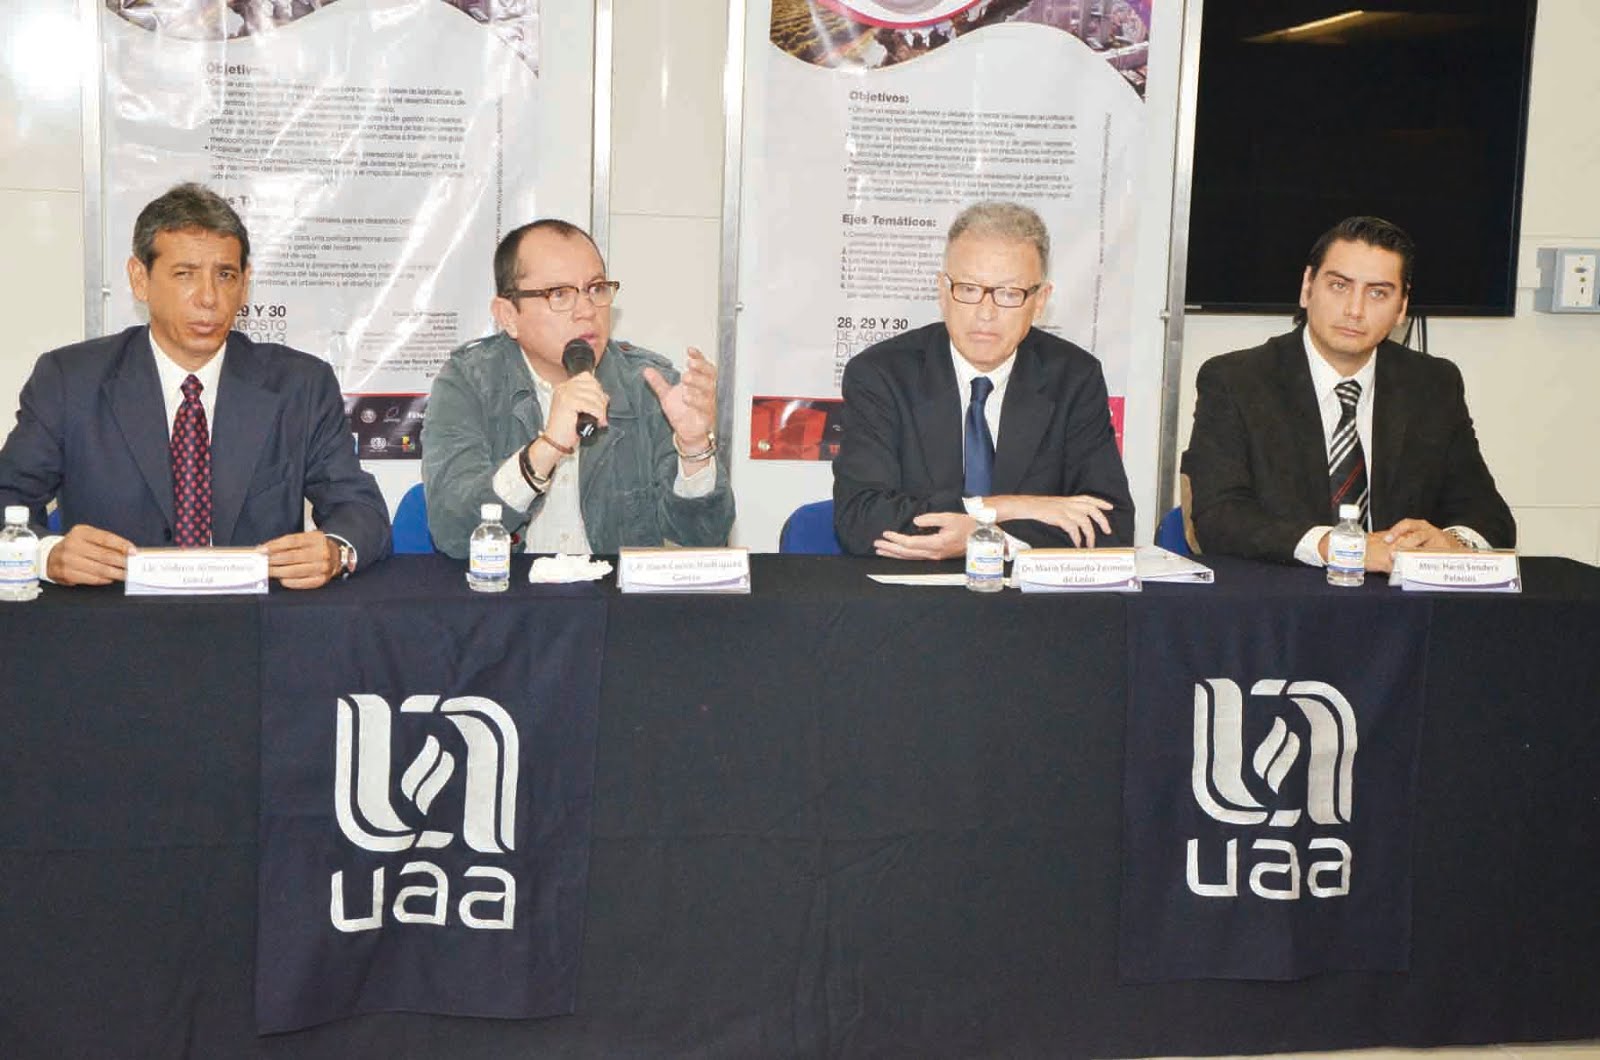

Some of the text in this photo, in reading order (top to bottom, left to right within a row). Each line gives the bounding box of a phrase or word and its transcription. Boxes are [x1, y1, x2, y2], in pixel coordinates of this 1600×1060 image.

[849, 91, 909, 104] Objetivos:
[842, 213, 937, 228] Ejes Temáticos:
[236, 304, 287, 318] 9 Y 30
[837, 316, 909, 330] 28, 29 Y 30
[1187, 838, 1352, 900] uaa
[331, 861, 516, 932] uaa
